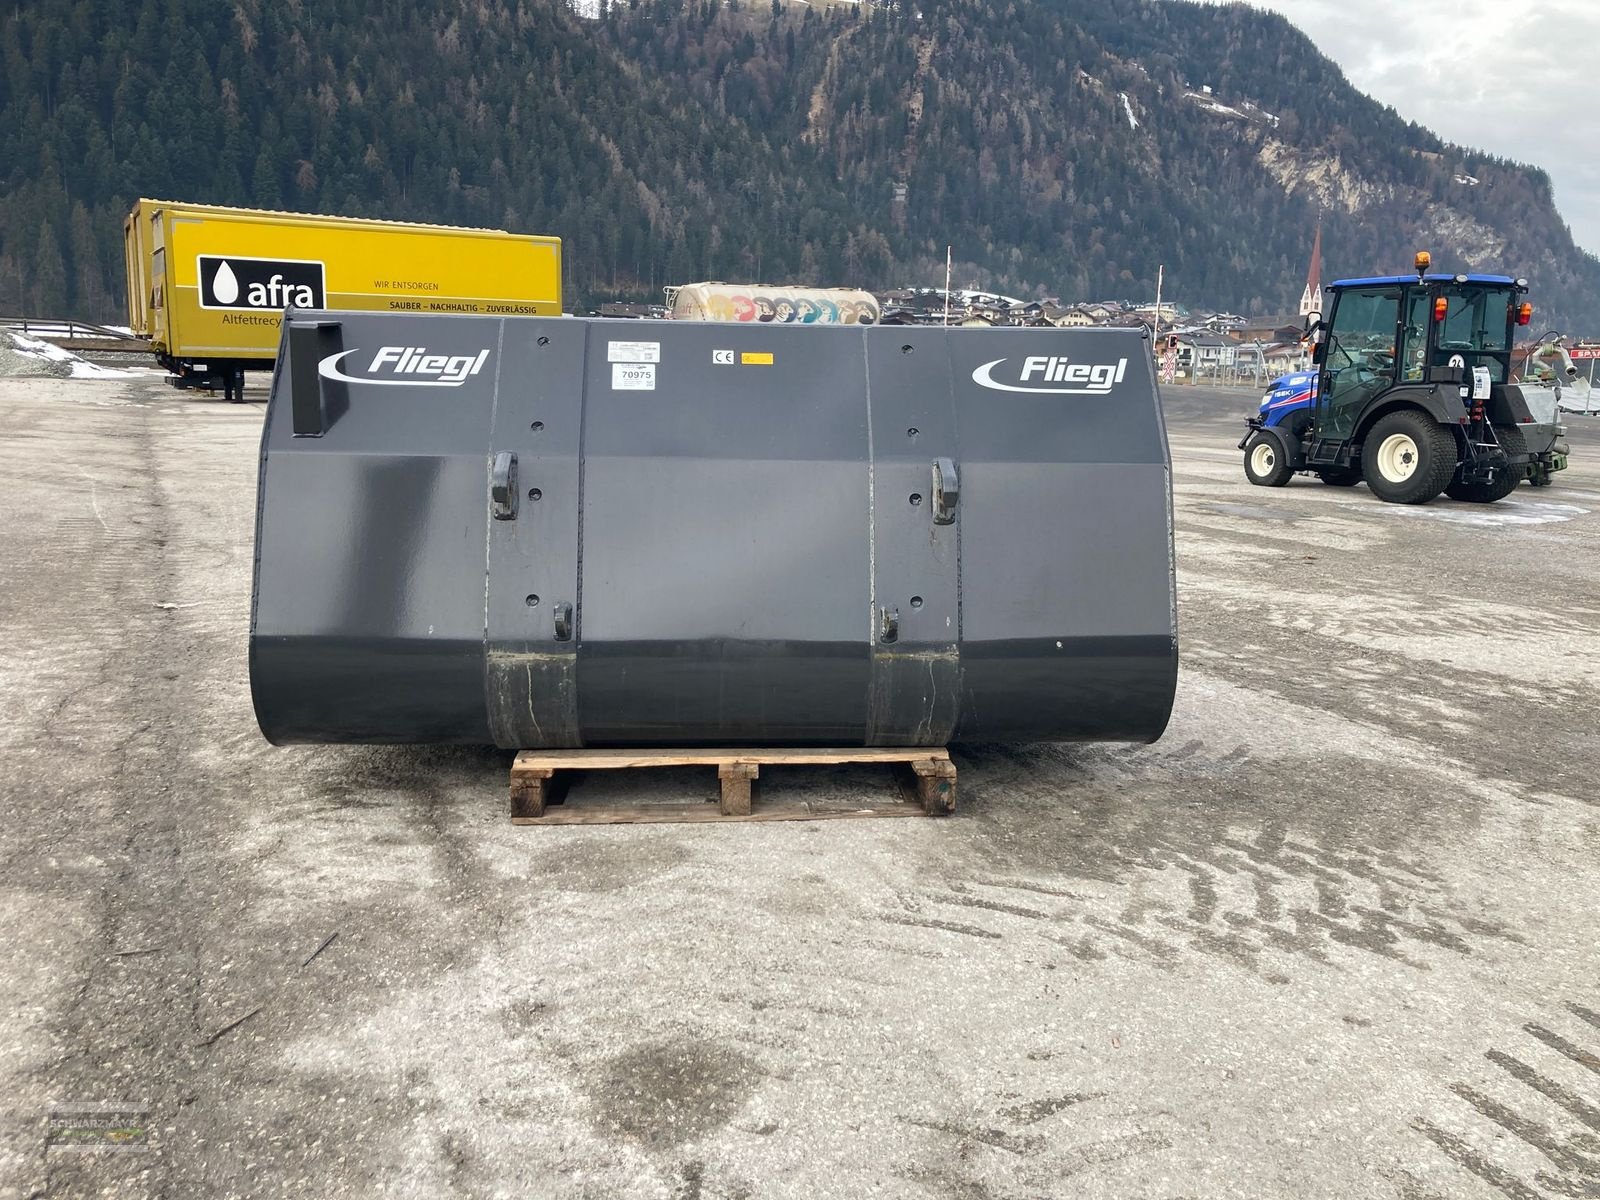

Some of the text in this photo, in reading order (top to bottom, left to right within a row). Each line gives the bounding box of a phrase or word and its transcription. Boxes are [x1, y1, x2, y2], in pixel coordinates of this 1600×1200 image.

[247, 274, 314, 308] afra
[373, 280, 439, 291] WIR ENTSORGEN
[389, 301, 421, 310] SAUBER
[430, 302, 478, 312] NACHHALTIG
[486, 304, 537, 314] ZUVERLÄSSIG
[367, 346, 490, 381] Fliegl
[622, 370, 652, 379] 70975
[1019, 356, 1128, 389] Fliegl
[1274, 389, 1294, 398] ISEKI
